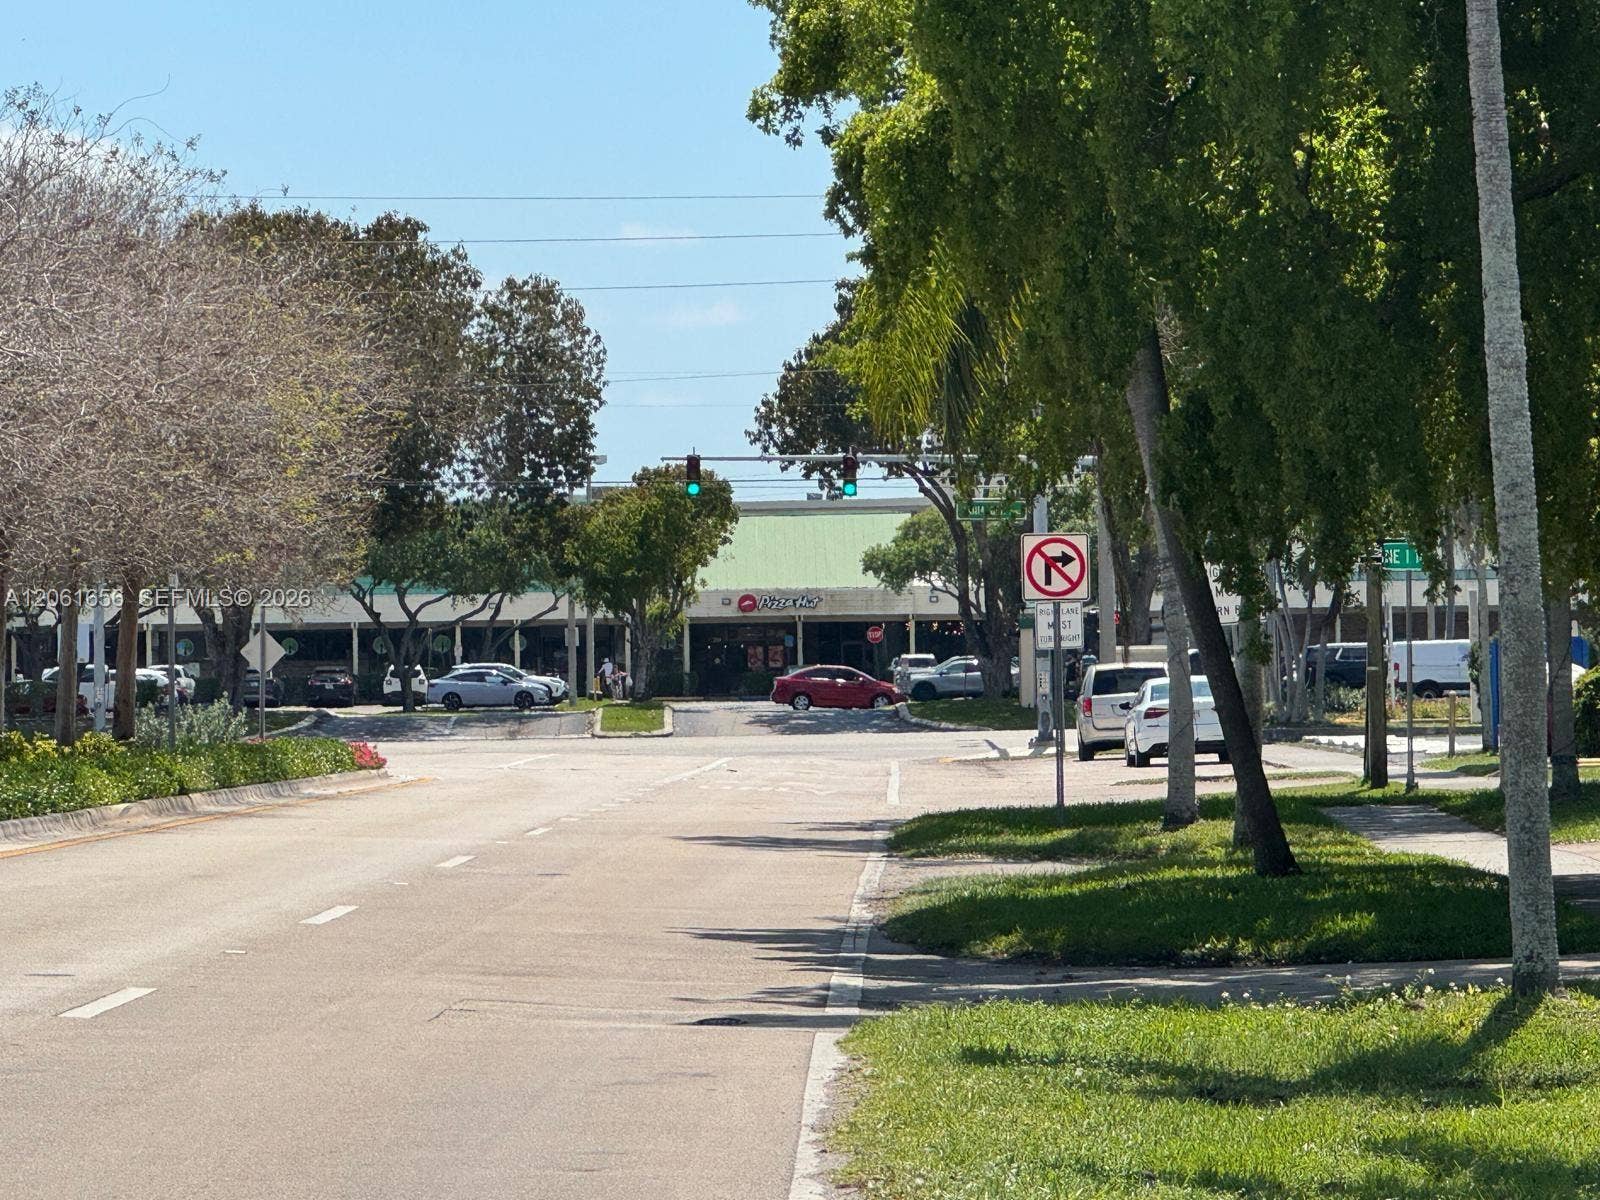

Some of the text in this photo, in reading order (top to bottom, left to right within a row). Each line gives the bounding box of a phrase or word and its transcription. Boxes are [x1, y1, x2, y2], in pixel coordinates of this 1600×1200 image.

[757, 595, 823, 610] Pizza Hut
[1061, 607, 1079, 615] LANE
[1047, 620, 1072, 630] MST
[1040, 635, 1053, 643] TUR
